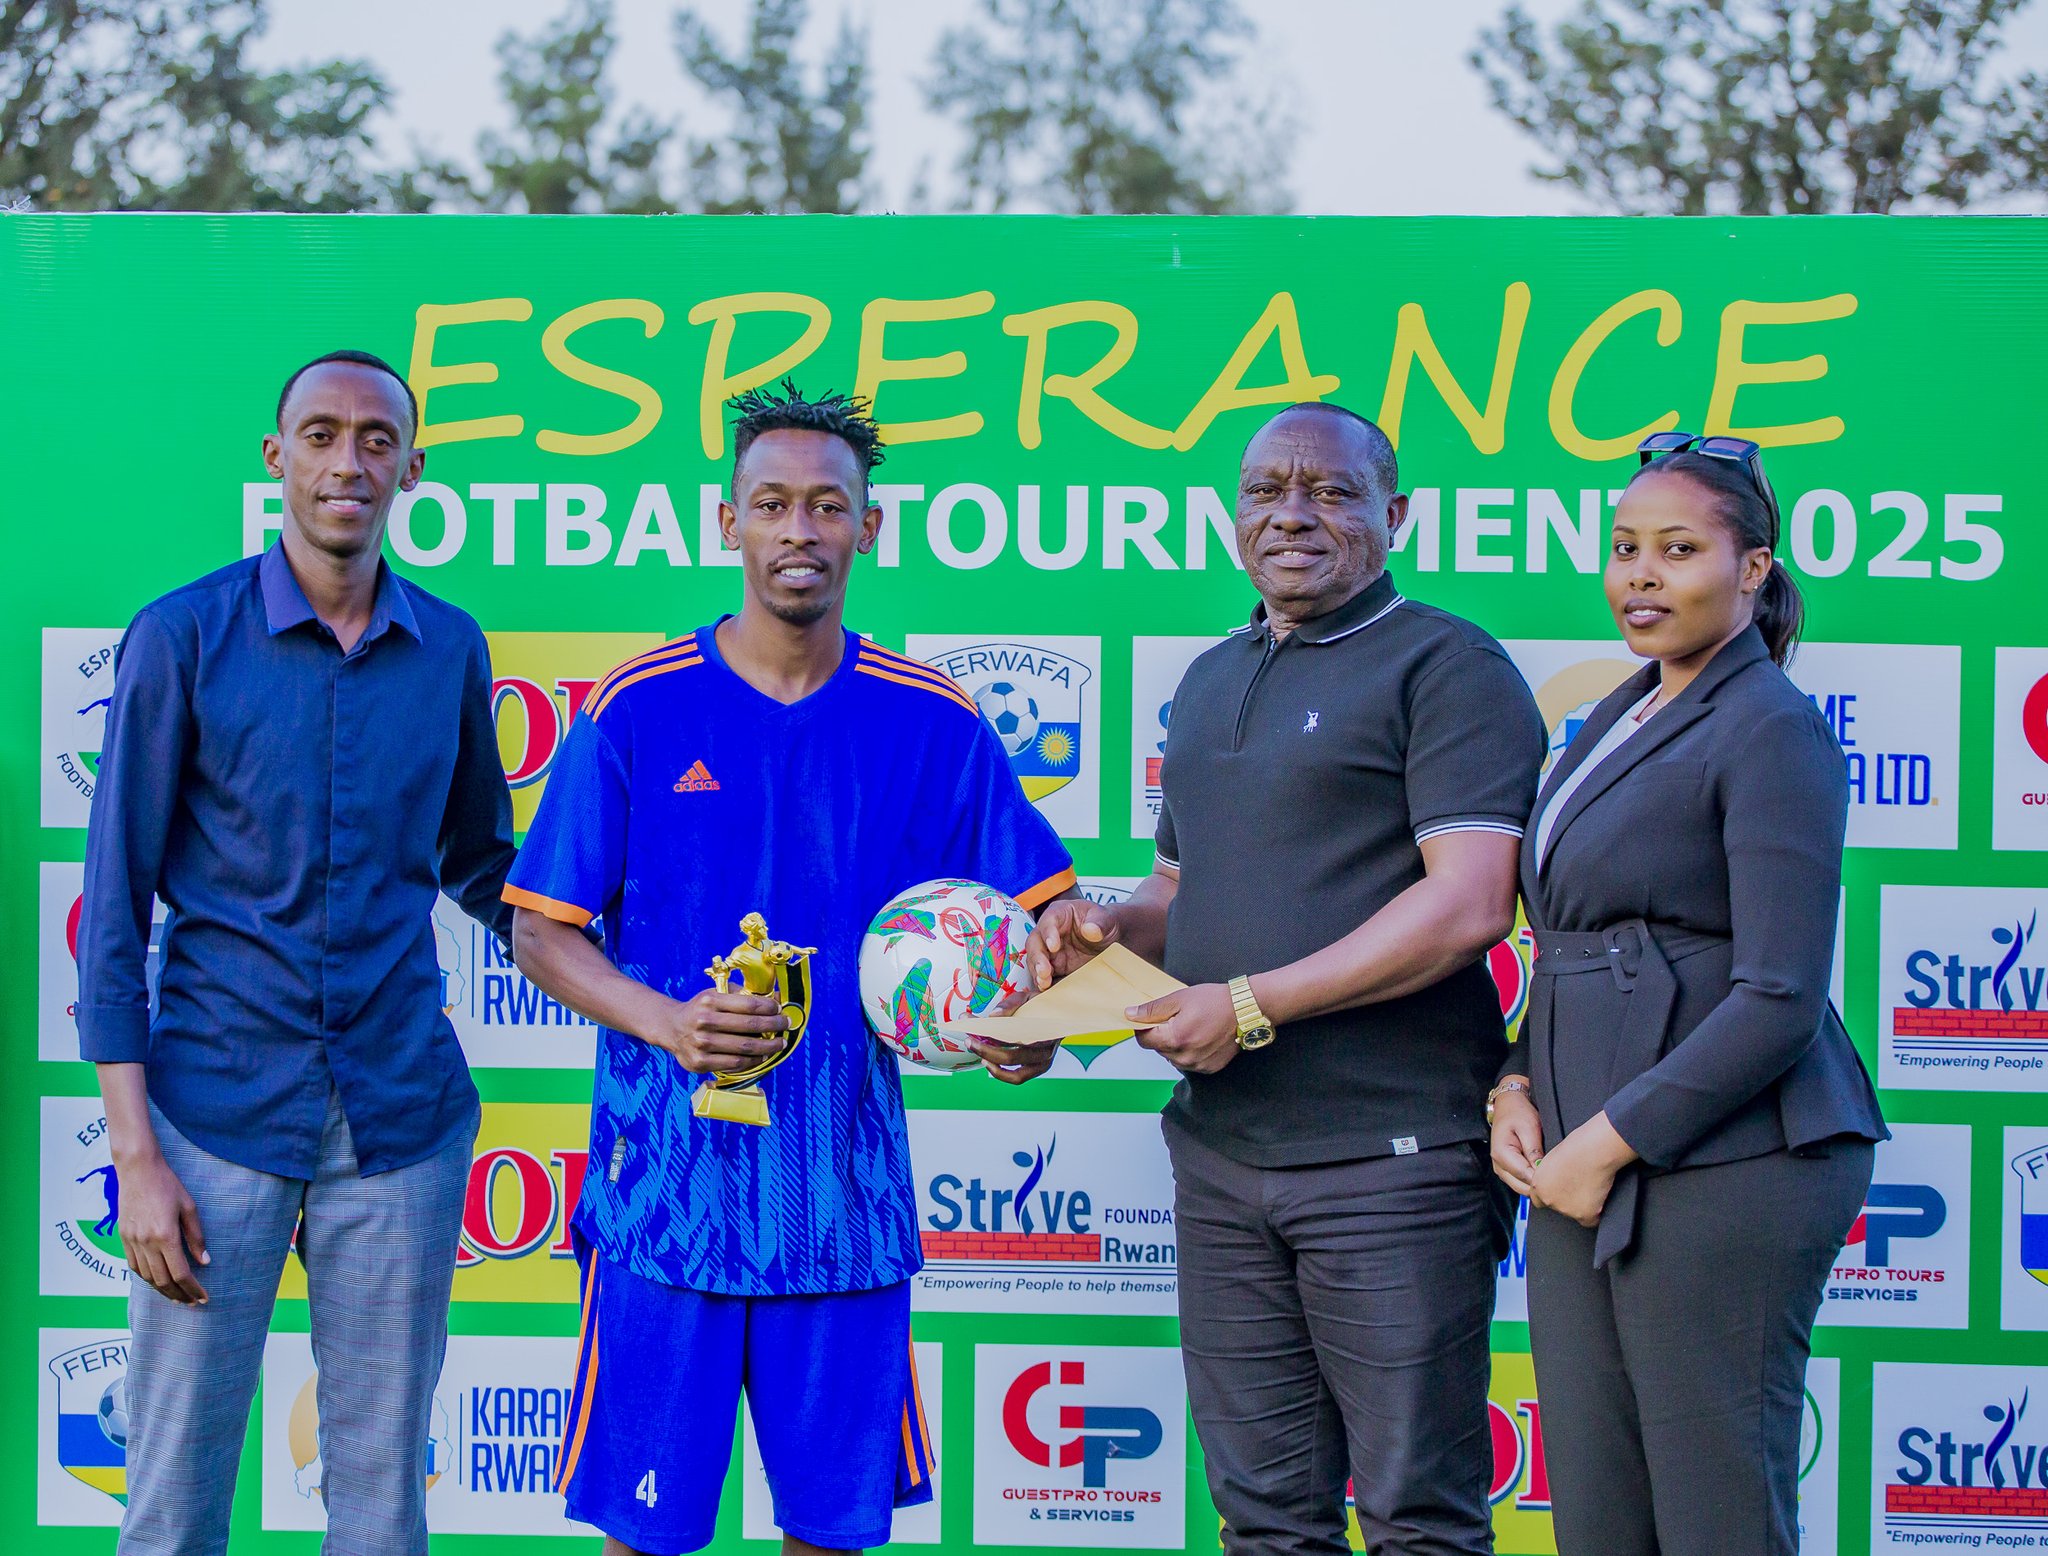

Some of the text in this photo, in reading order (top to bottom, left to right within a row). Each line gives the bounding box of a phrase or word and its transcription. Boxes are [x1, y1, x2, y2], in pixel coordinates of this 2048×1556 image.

[412, 281, 1858, 461] ESPERANCE
[243, 481, 2004, 580] FOTBAL TOURNMEN 025
[936, 651, 1070, 689] ERWAFA
[57, 752, 94, 800] FOOTB
[673, 778, 721, 793] adidas
[1994, 1056, 2043, 1072] People
[928, 1143, 1091, 1238] Strive
[1105, 1209, 1174, 1224] FOUNDA
[55, 1221, 116, 1278] FOOTBALL
[1016, 1279, 1063, 1292] People
[1068, 1281, 1081, 1291] to
[1086, 1280, 1116, 1294] help
[1827, 1268, 1945, 1282] TPRO TOURS
[1828, 1288, 1918, 1301] SERVICES
[63, 1346, 129, 1380] FER
[472, 1387, 572, 1437] KARA
[472, 1443, 560, 1493] RWA
[636, 1470, 657, 1508] 4
[1003, 1488, 1162, 1502] GUESTPRO TOURS
[1030, 1508, 1135, 1521] & SERVICES
[1986, 1533, 2035, 1548] People
